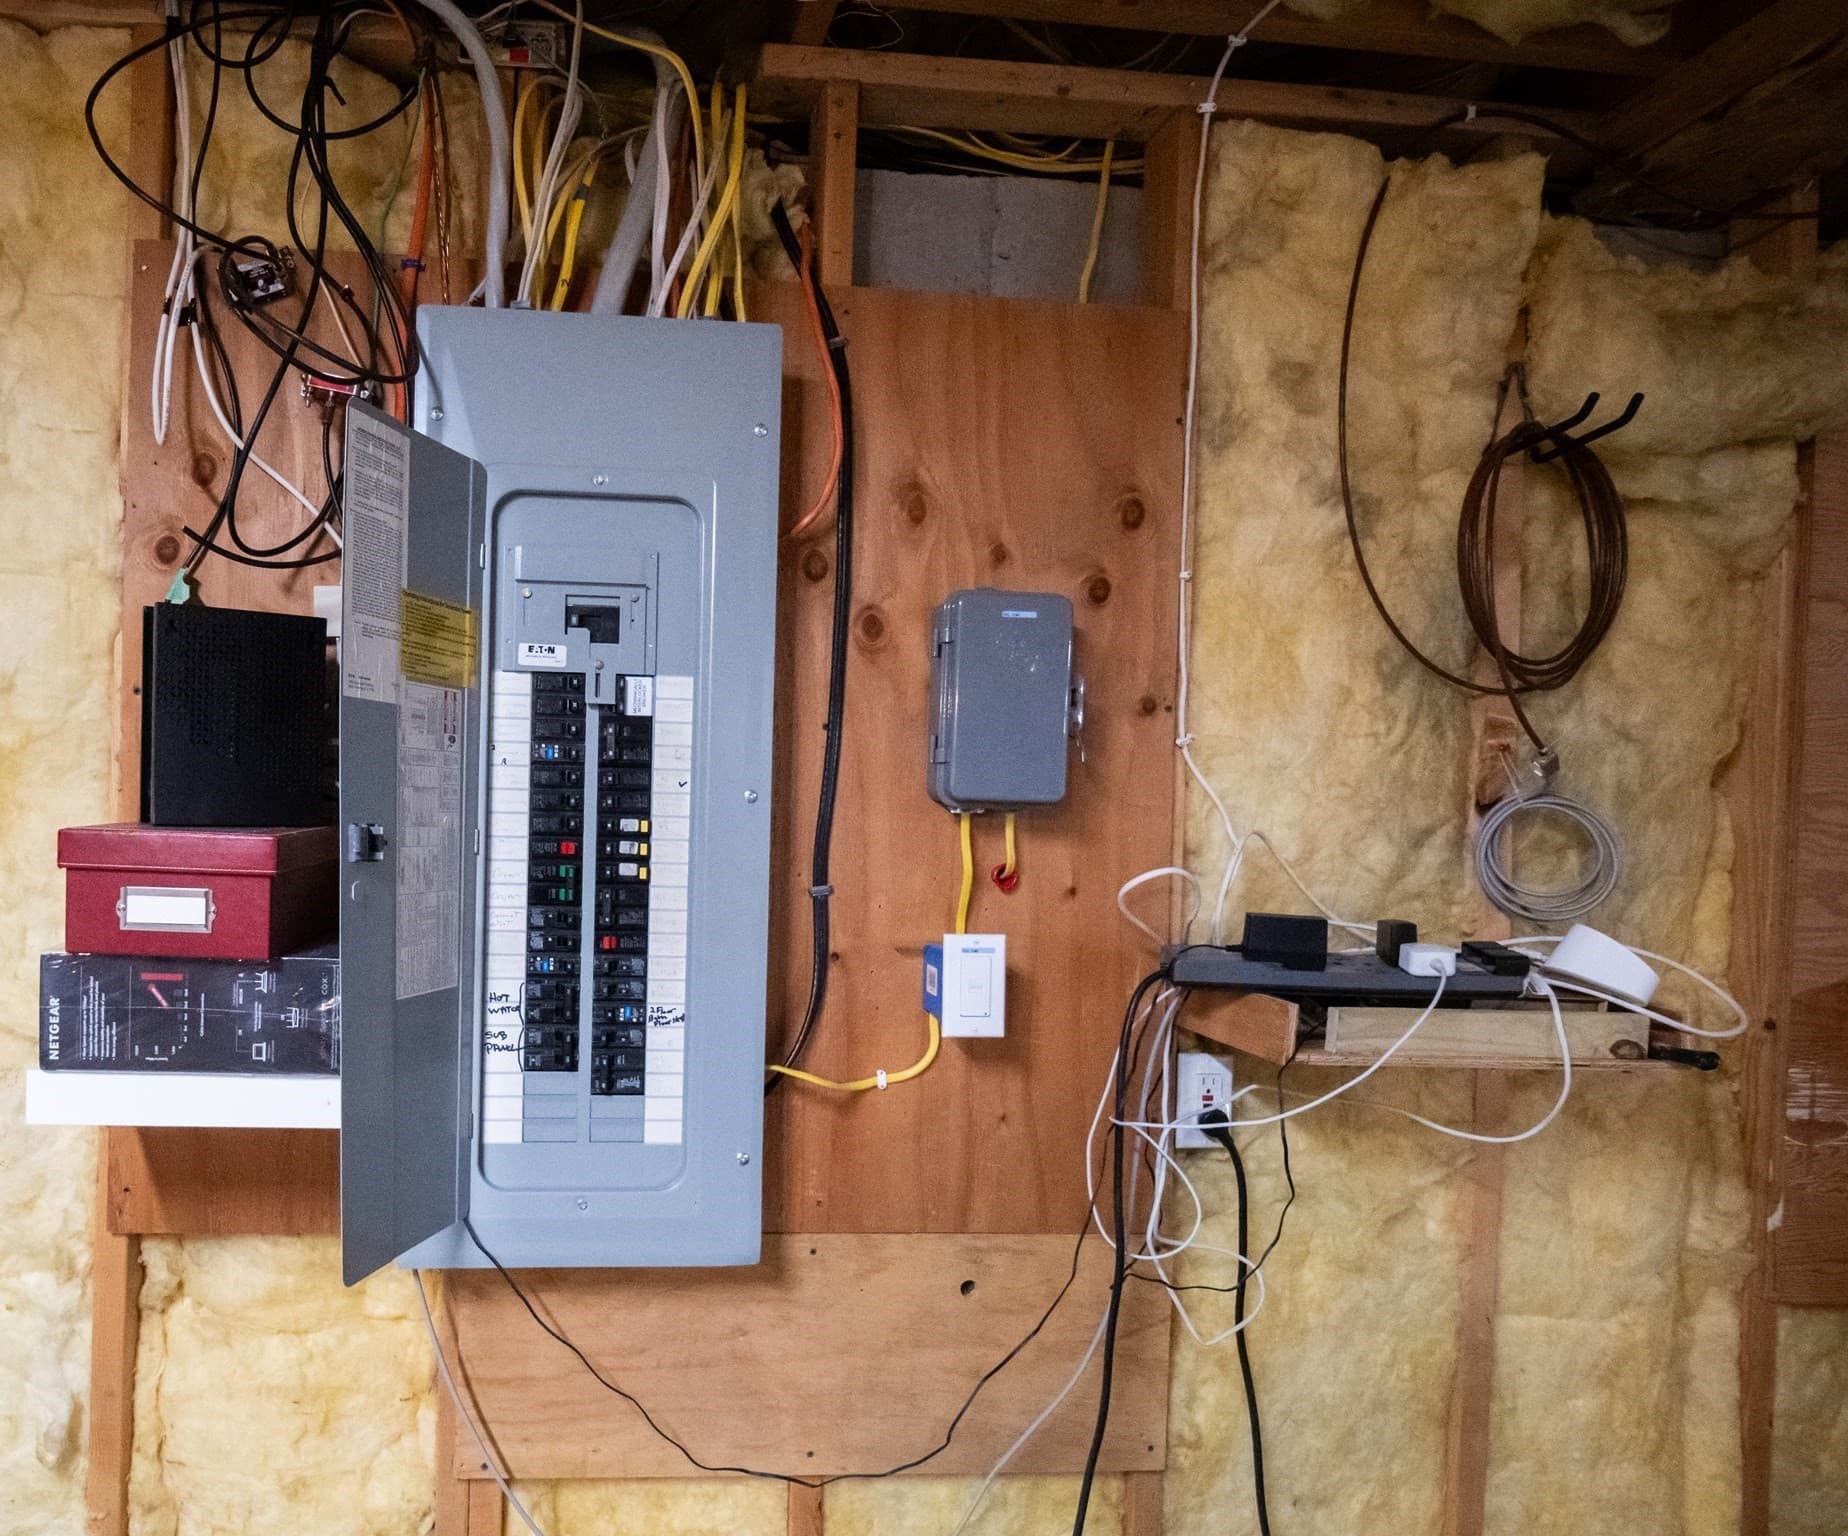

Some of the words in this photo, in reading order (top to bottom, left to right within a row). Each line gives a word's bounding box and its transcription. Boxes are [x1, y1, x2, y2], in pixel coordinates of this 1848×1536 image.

[320, 977, 328, 996] COX
[489, 992, 510, 1003] HOT
[49, 996, 60, 1061] NETGEAR
[484, 1031, 508, 1040] SUB
